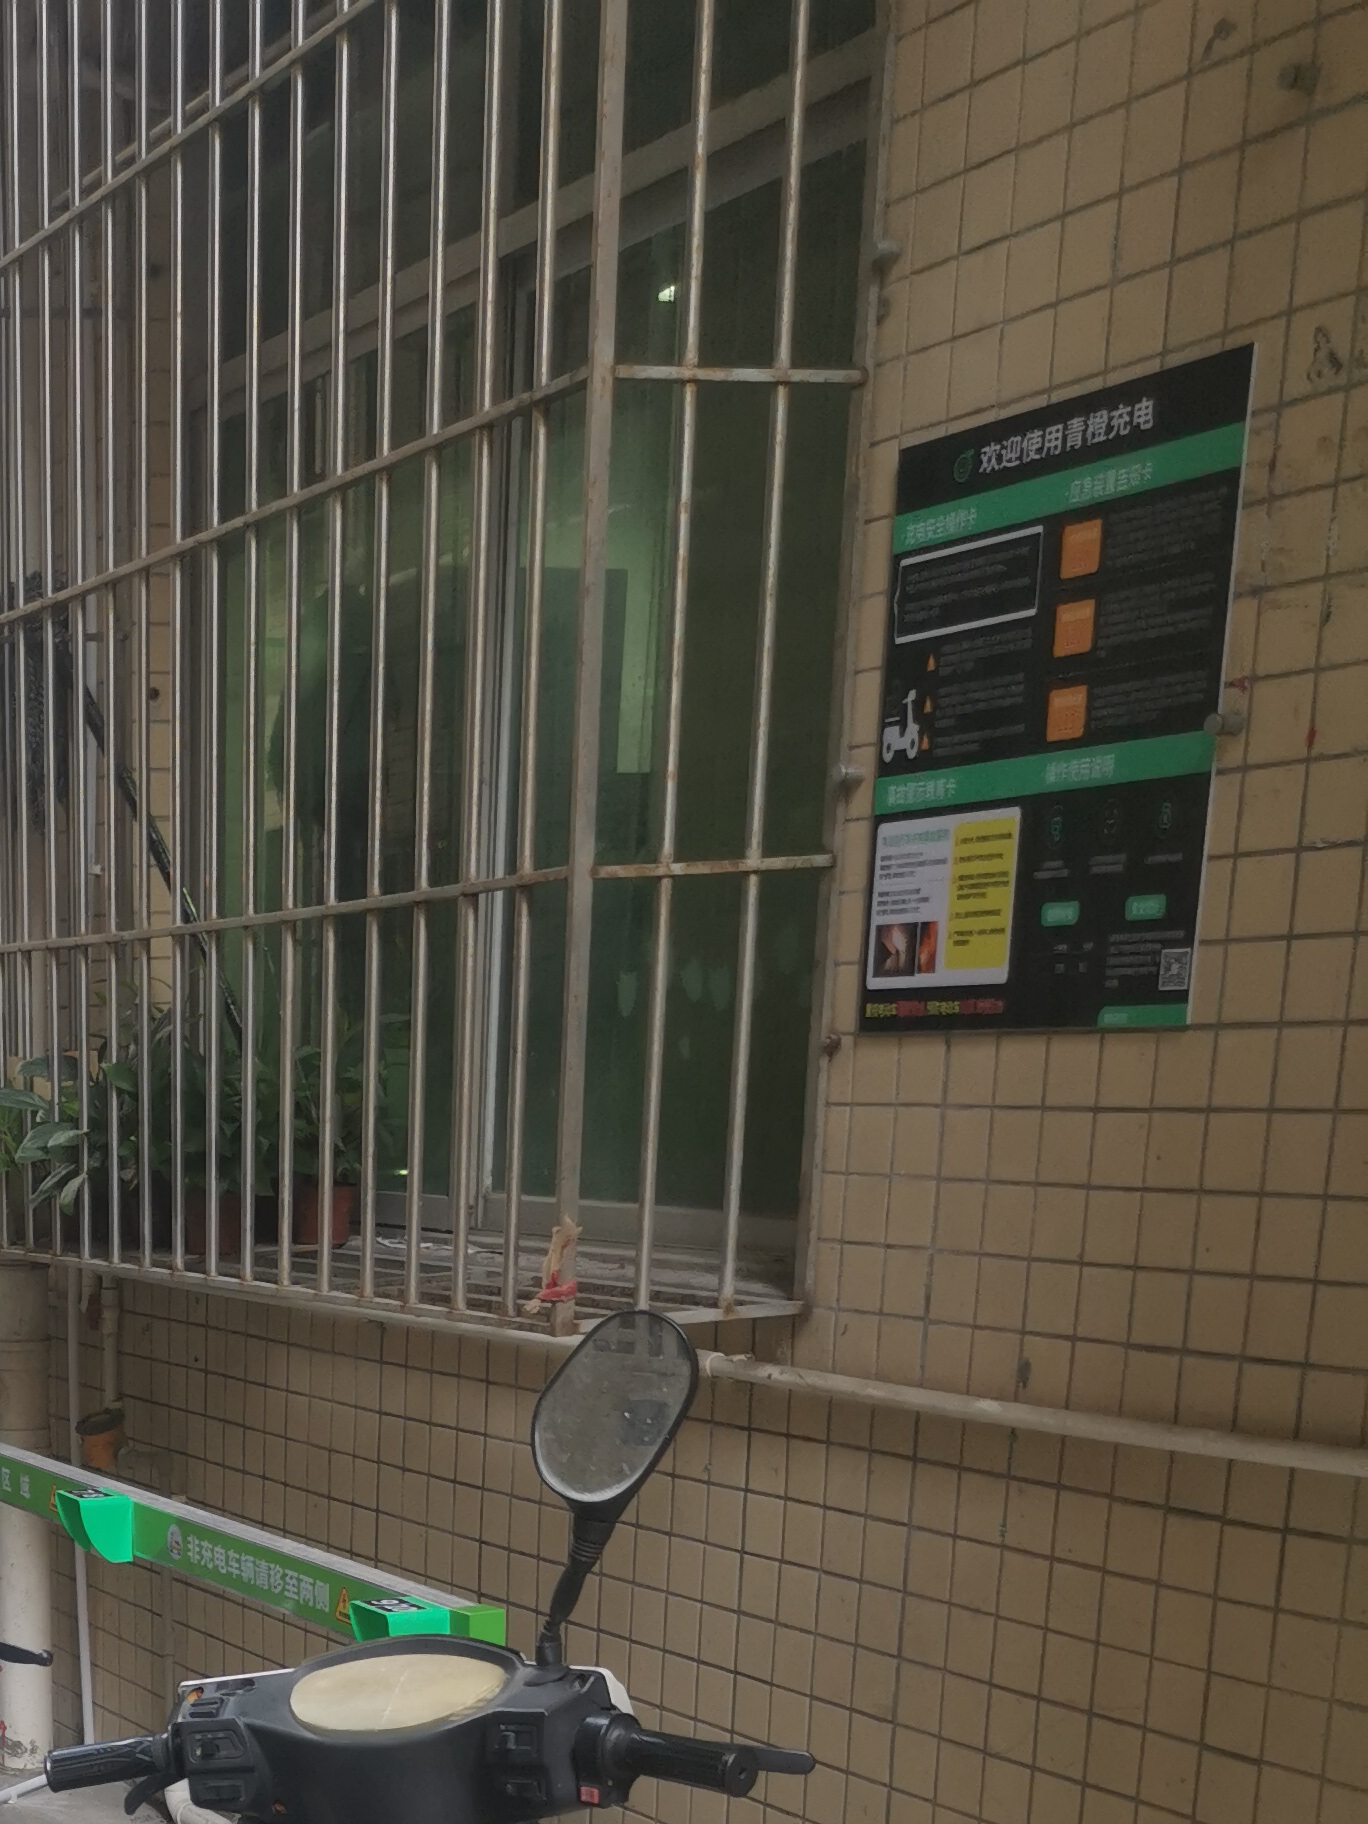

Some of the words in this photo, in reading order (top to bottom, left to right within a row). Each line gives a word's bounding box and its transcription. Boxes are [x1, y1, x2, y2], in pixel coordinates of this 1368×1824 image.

[979, 397, 1155, 474] 欢迎使用青橙充电
[187, 1534, 330, 1613] 非充电车辆请移至两侧
